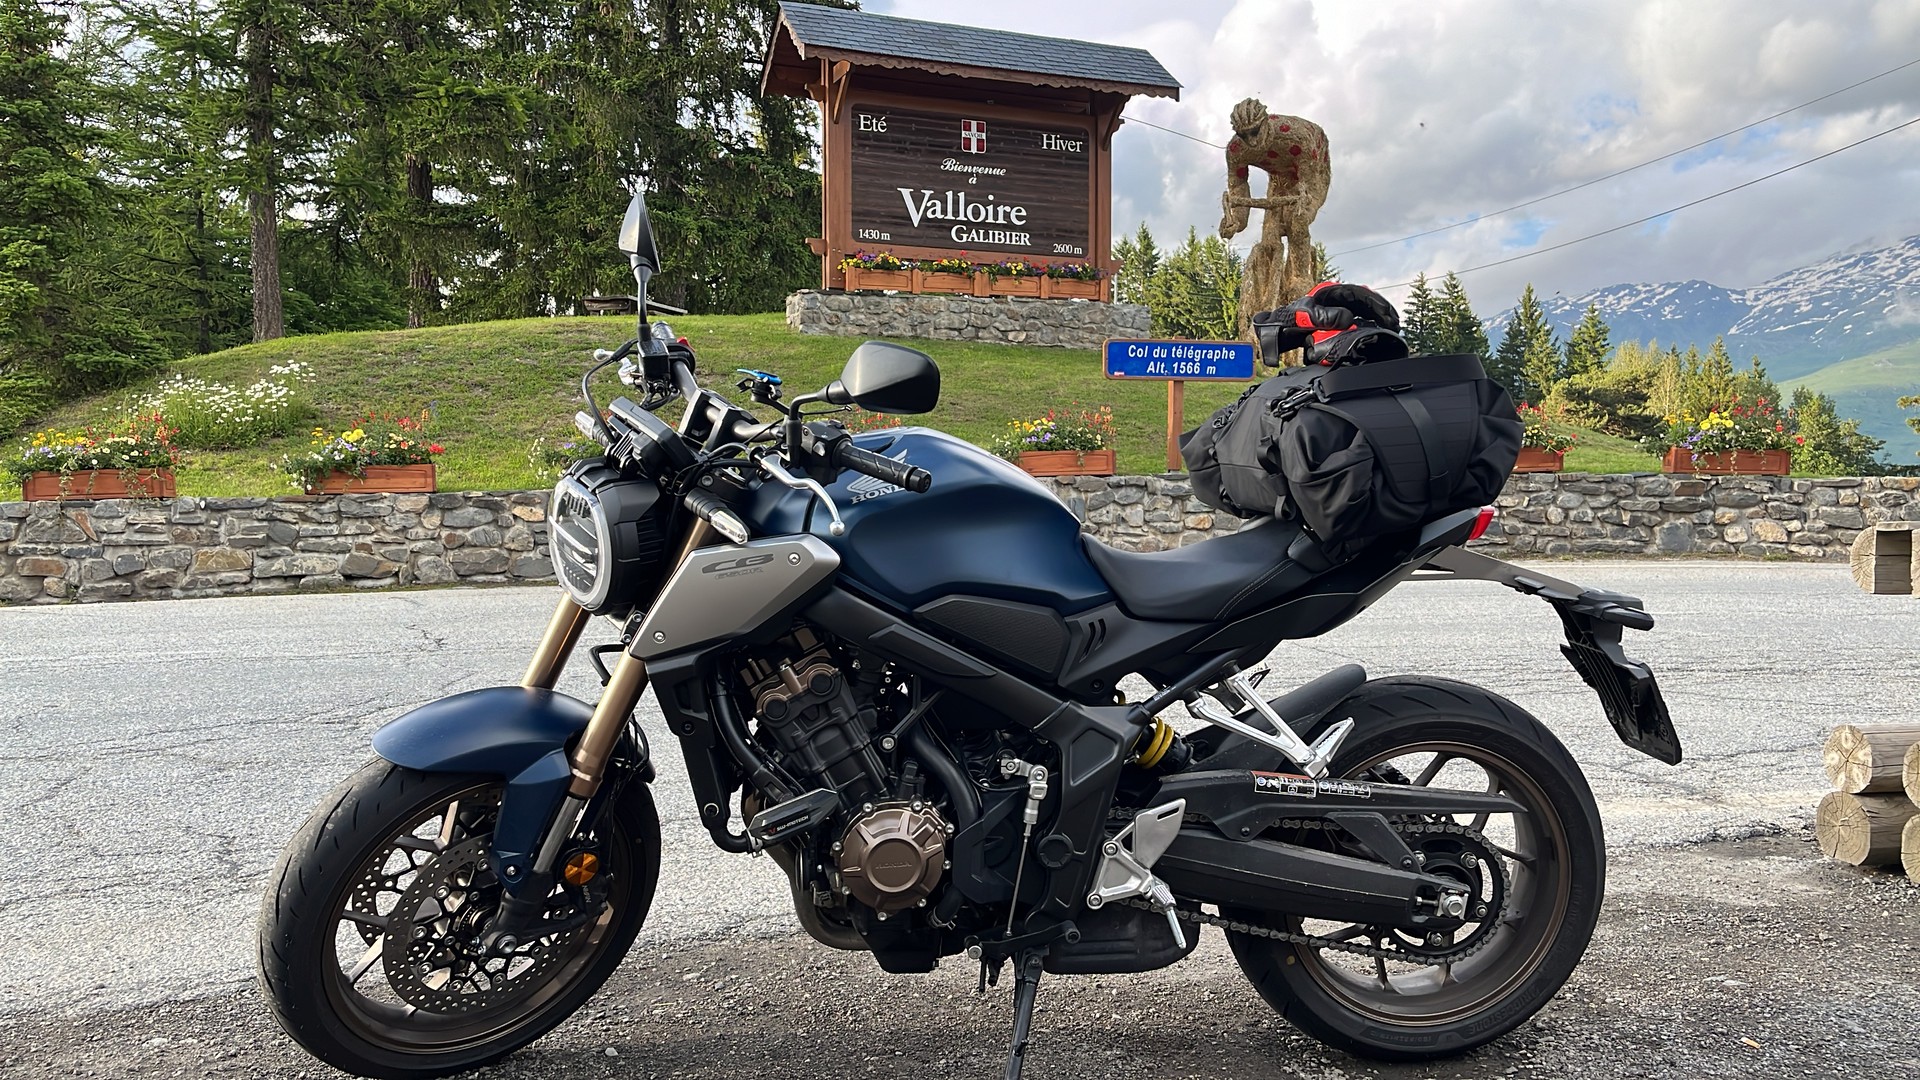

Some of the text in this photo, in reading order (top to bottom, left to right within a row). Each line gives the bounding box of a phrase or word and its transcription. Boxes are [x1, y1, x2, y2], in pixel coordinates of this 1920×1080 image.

[858, 113, 888, 133] Eté
[1041, 133, 1083, 153] Hiver
[940, 157, 1007, 176] Bienvenue
[968, 173, 978, 185] à
[896, 187, 1027, 228] Valloire
[858, 228, 891, 241] 1430 m
[950, 224, 1032, 246] GALIBIER
[1053, 243, 1083, 255] 2600 m
[1128, 345, 1236, 362] Col du télégraphe
[1146, 361, 1216, 375] Alt. 1566 m
[851, 484, 906, 505] HON
